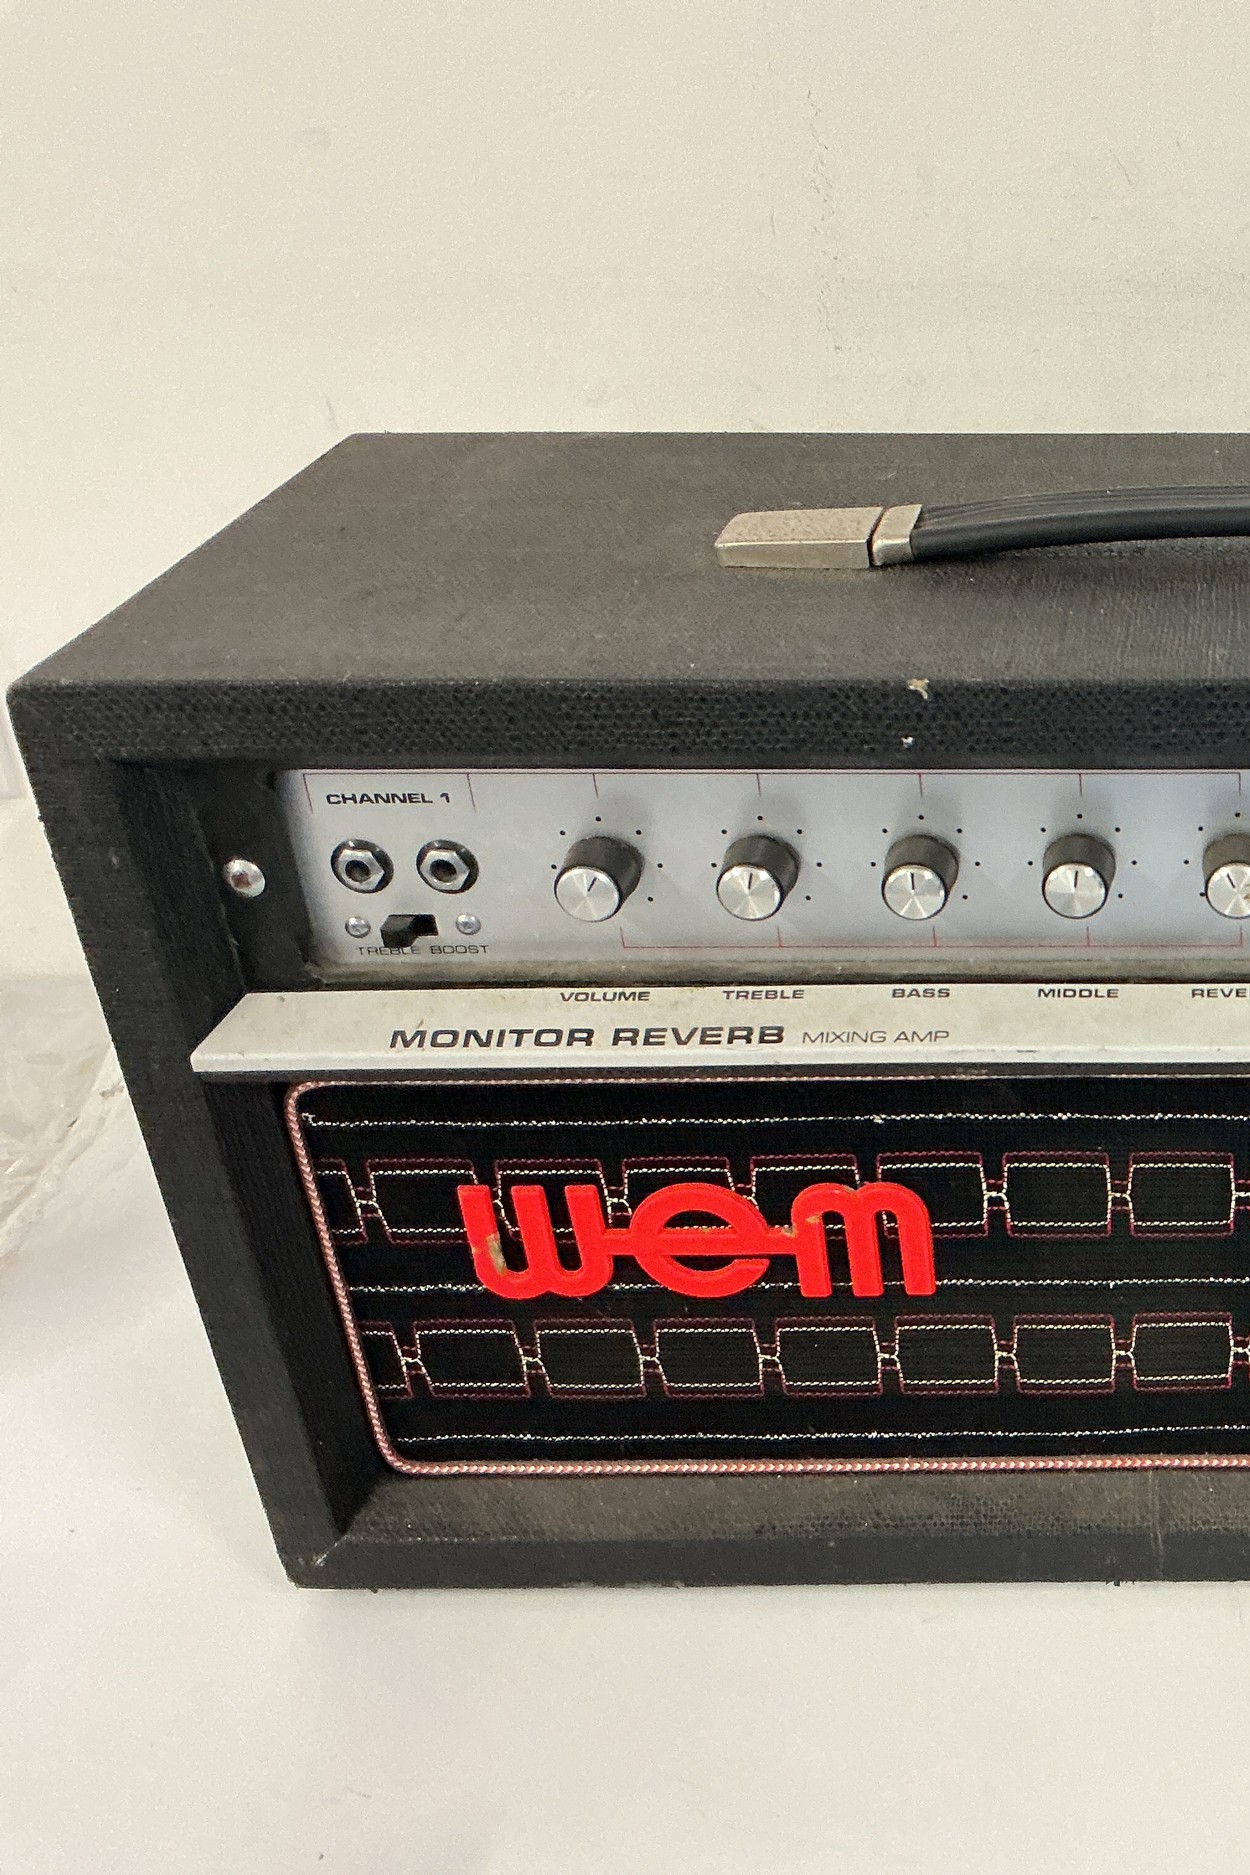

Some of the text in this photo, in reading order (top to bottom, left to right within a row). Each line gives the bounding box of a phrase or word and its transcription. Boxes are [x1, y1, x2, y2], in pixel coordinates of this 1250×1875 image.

[326, 792, 450, 804] CHANNEL 1
[358, 944, 489, 956] TREBLE BOOST
[560, 990, 651, 1003] VOLUME
[722, 988, 805, 1001] TREBLE
[891, 987, 951, 999] BASS
[1037, 987, 1120, 999] MIDDLE
[389, 1025, 950, 1049] MONITOR REVERB MIXING AMP
